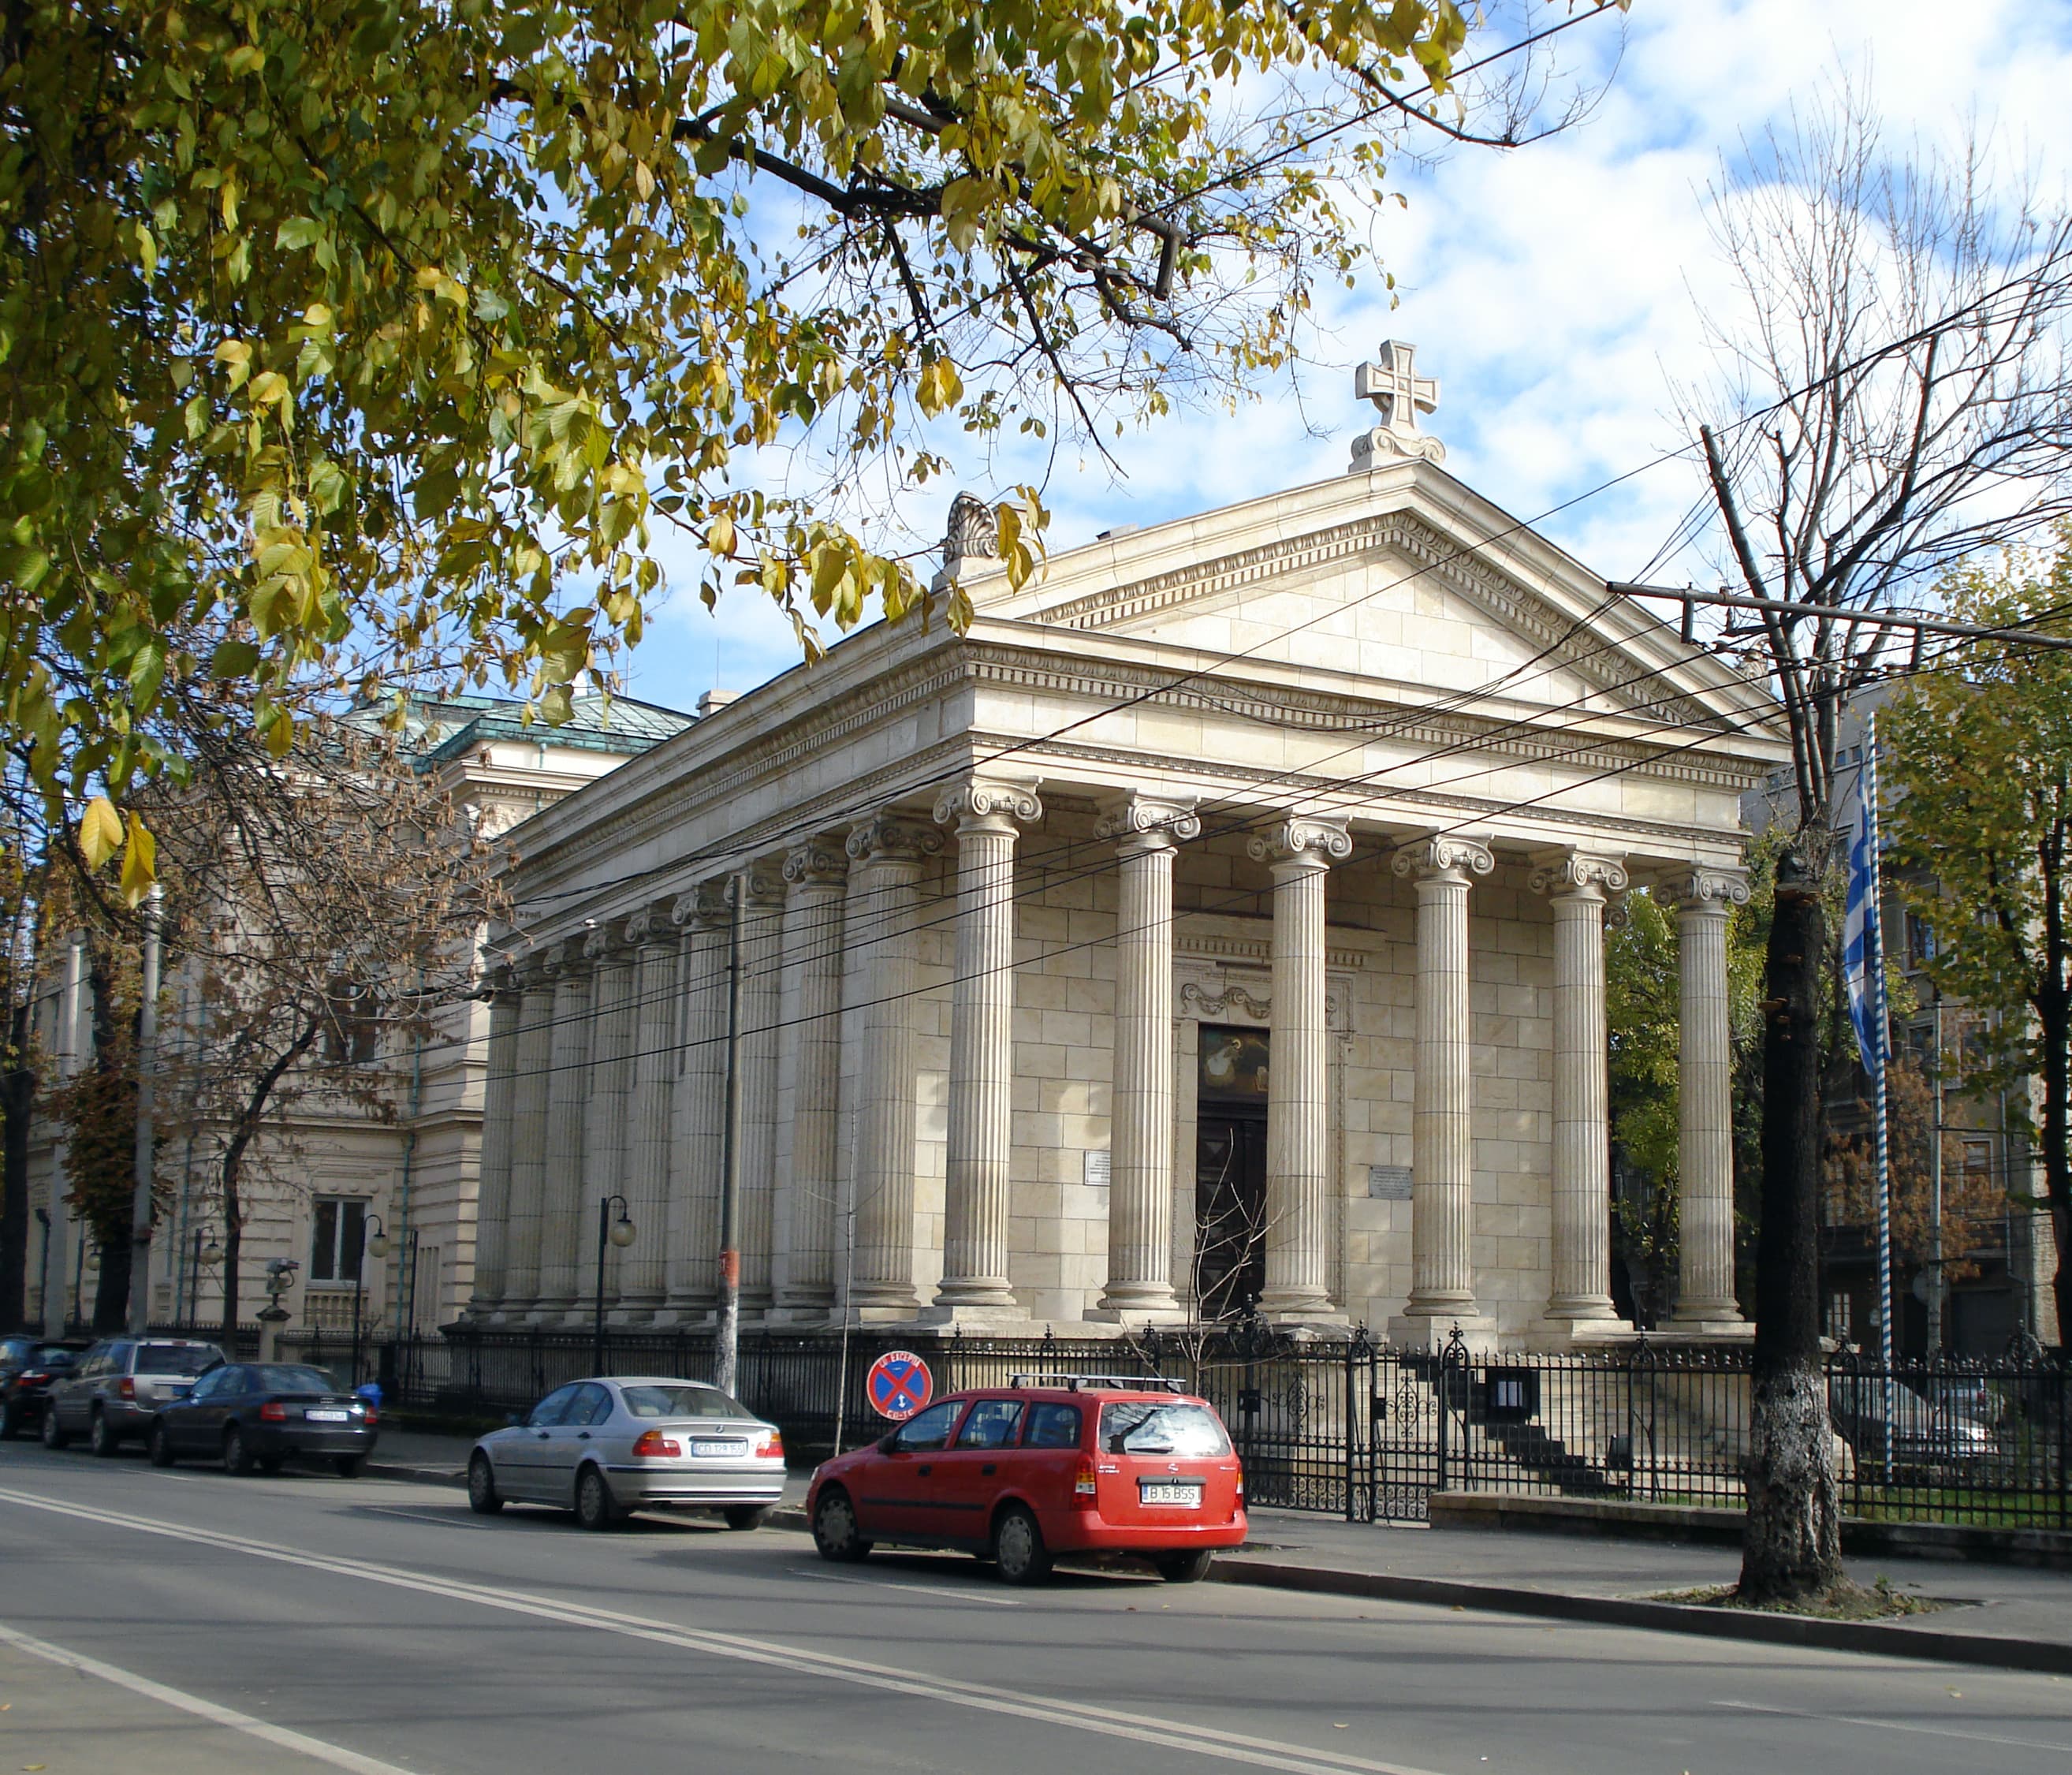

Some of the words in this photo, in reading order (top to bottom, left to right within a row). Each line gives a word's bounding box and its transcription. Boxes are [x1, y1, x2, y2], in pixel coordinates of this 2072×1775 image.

[1150, 1487, 1157, 1499] B
[1162, 1487, 1171, 1499] 15
[1174, 1487, 1194, 1501] BSS
